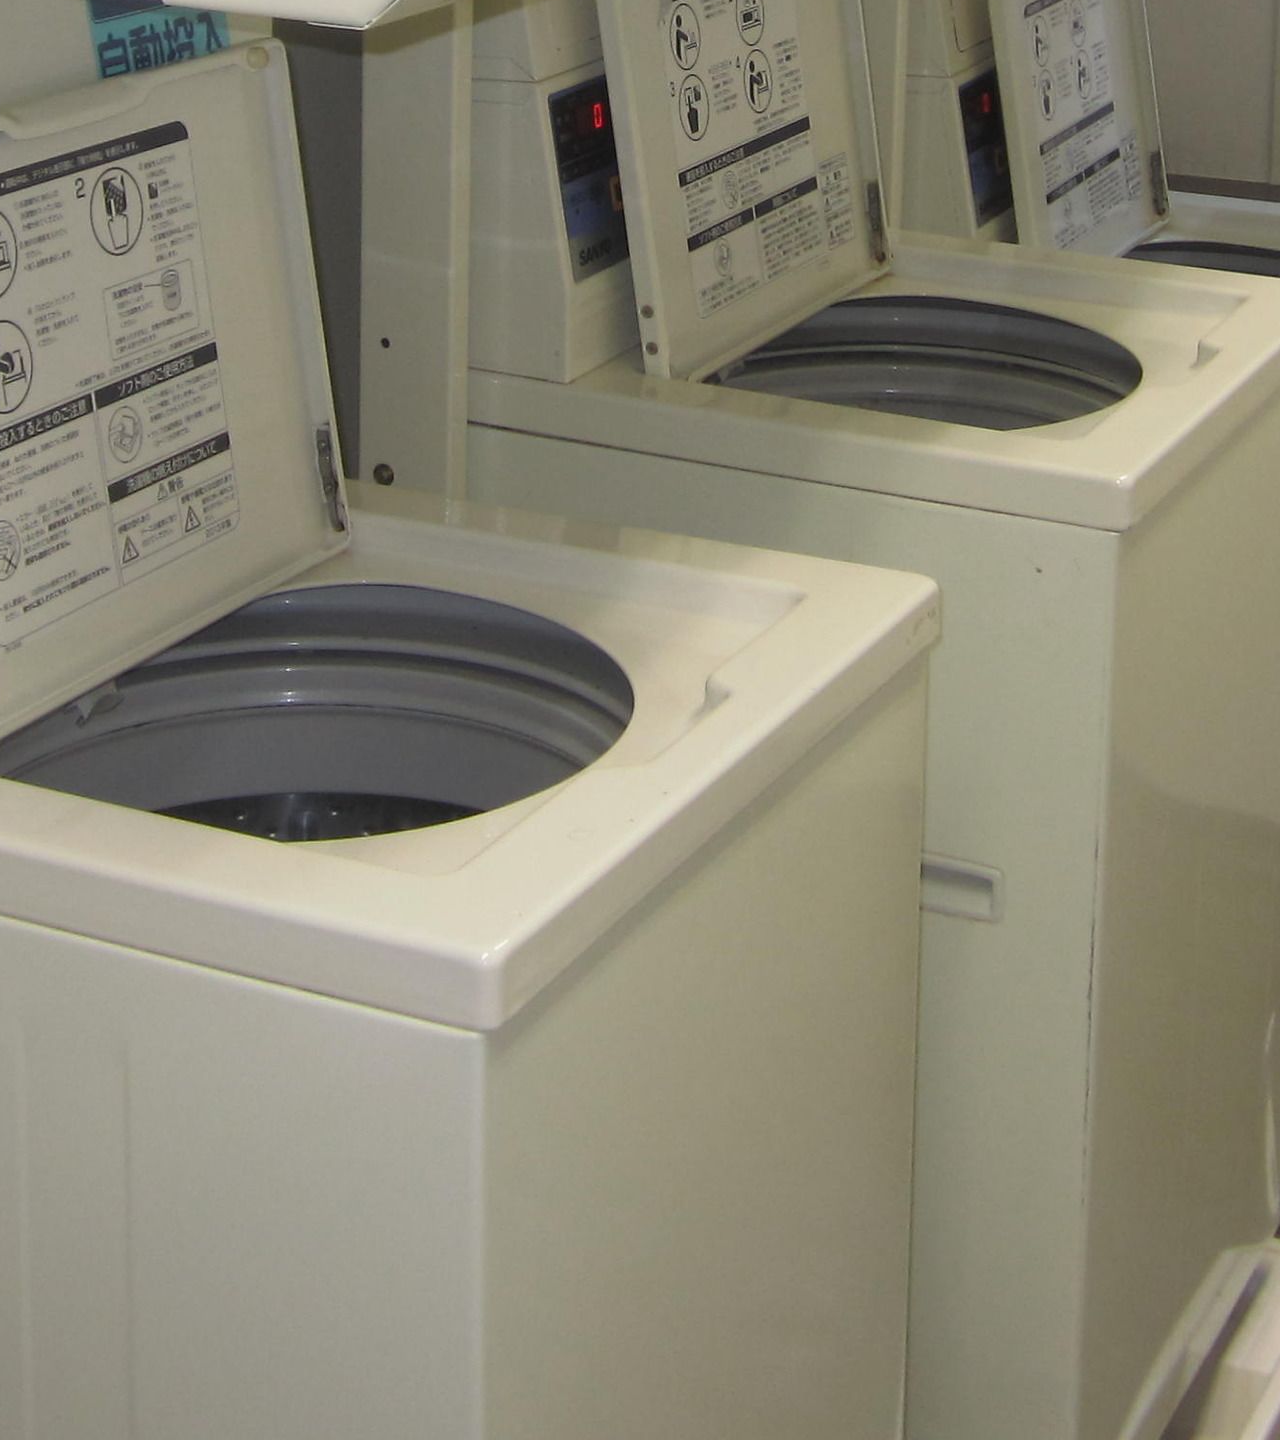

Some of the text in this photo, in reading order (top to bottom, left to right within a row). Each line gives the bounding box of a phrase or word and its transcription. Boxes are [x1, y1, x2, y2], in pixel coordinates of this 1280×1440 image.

[97, 11, 223, 79] 自動投入
[74, 177, 87, 200] 2
